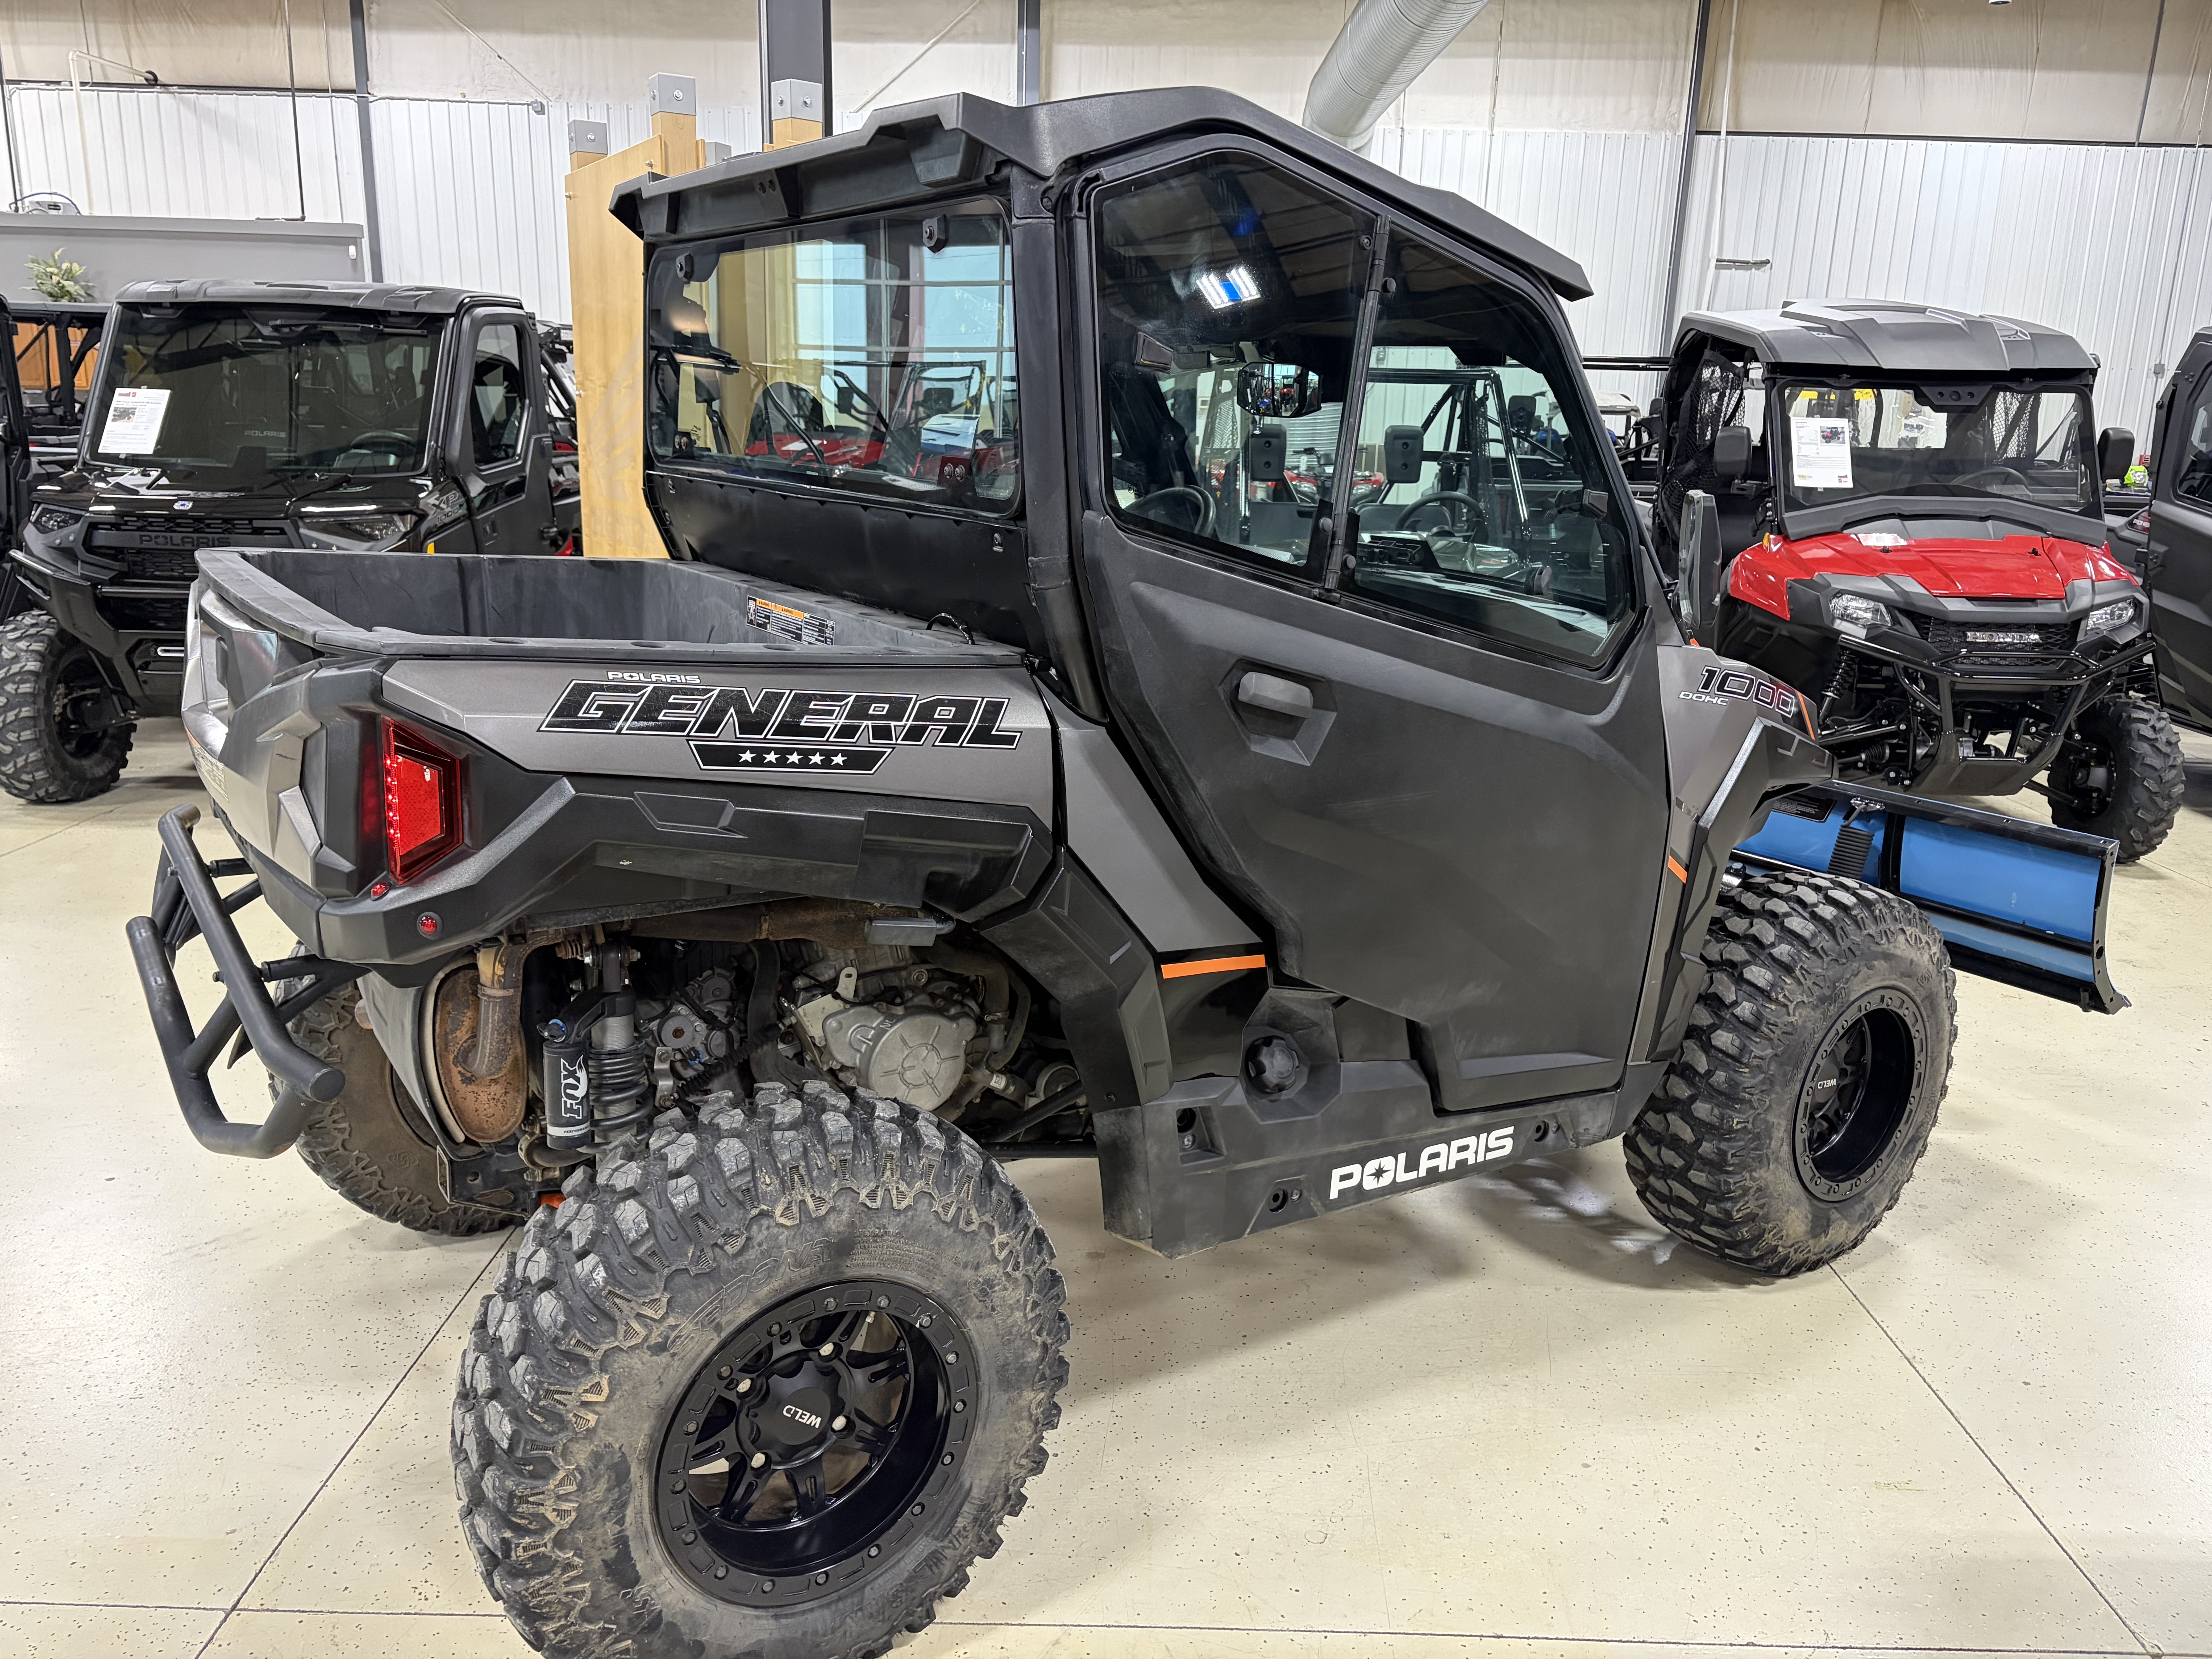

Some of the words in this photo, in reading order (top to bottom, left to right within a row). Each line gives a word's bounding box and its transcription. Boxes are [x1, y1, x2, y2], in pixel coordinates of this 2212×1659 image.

[139, 534, 231, 547] POLARIS
[1965, 631, 2042, 643] HONDA
[607, 671, 702, 684] POLARIS
[1678, 691, 1729, 706] DOHC
[1697, 665, 1795, 718] 1000
[536, 678, 1023, 750] GENERAL
[560, 1054, 588, 1119] FOX
[1817, 1078, 1837, 1089] WELD
[563, 1125, 589, 1133] PERFORMAN
[1329, 1125, 1515, 1200] POLARIS
[782, 1405, 822, 1429] WELD
